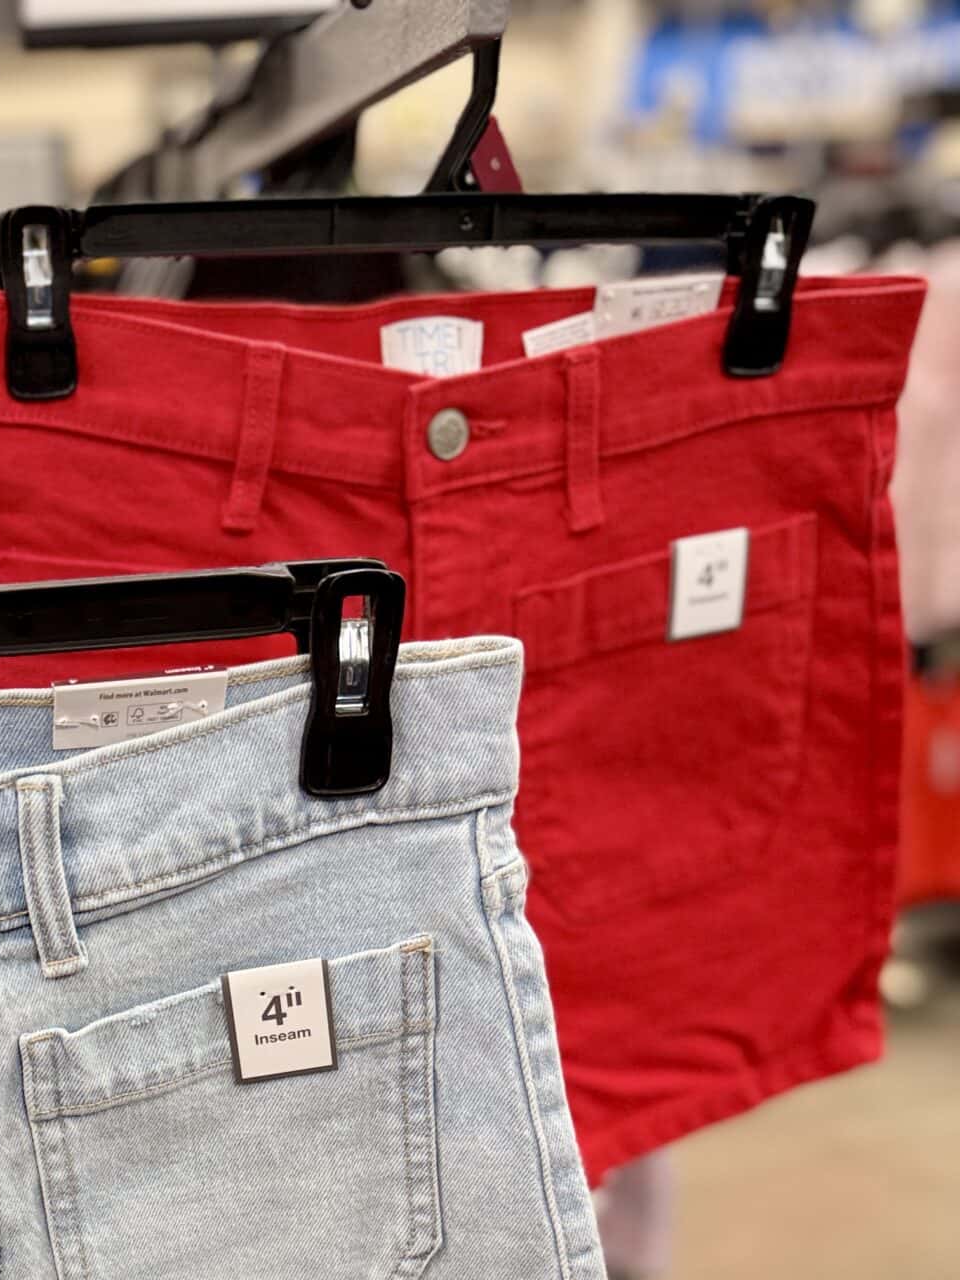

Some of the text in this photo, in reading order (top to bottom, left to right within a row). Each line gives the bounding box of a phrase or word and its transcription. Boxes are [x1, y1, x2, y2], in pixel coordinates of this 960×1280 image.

[99, 692, 114, 701] Find
[135, 690, 142, 698] at
[143, 687, 189, 697] Walmart.com
[261, 991, 302, 1026] 4"
[254, 1028, 312, 1046] Inseam
